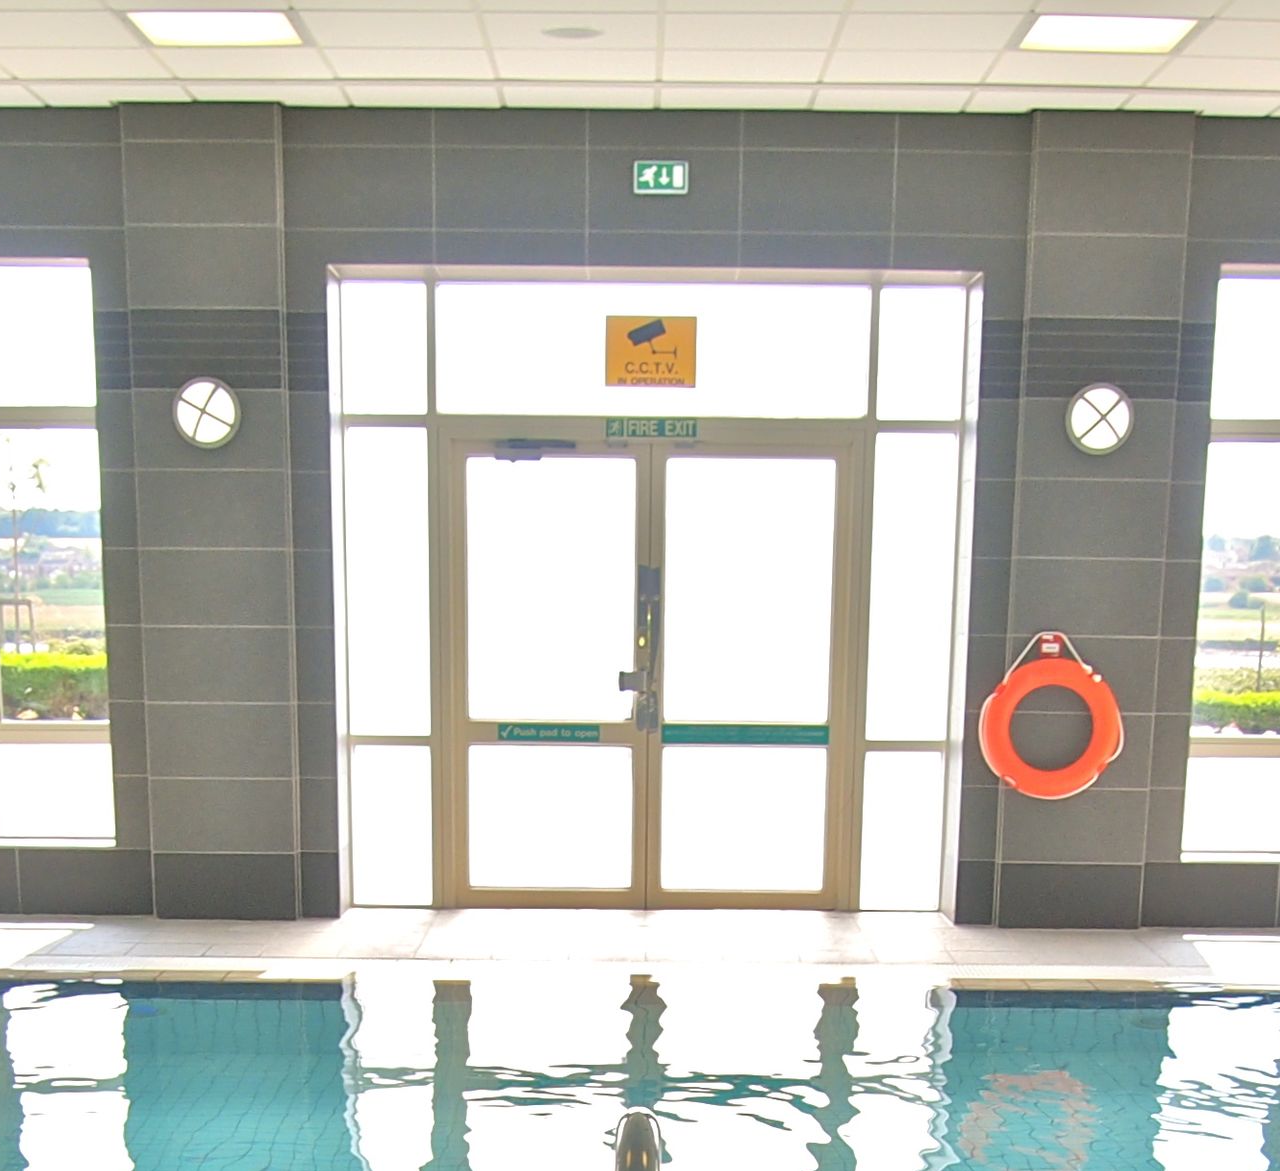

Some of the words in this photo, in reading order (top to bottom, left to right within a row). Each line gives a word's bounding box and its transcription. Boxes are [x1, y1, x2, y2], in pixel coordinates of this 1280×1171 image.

[629, 420, 658, 435] FIRE
[665, 420, 696, 436] EXIT
[513, 727, 537, 737] Push
[539, 728, 558, 738] pad
[561, 728, 571, 737] to
[574, 729, 598, 738] open
